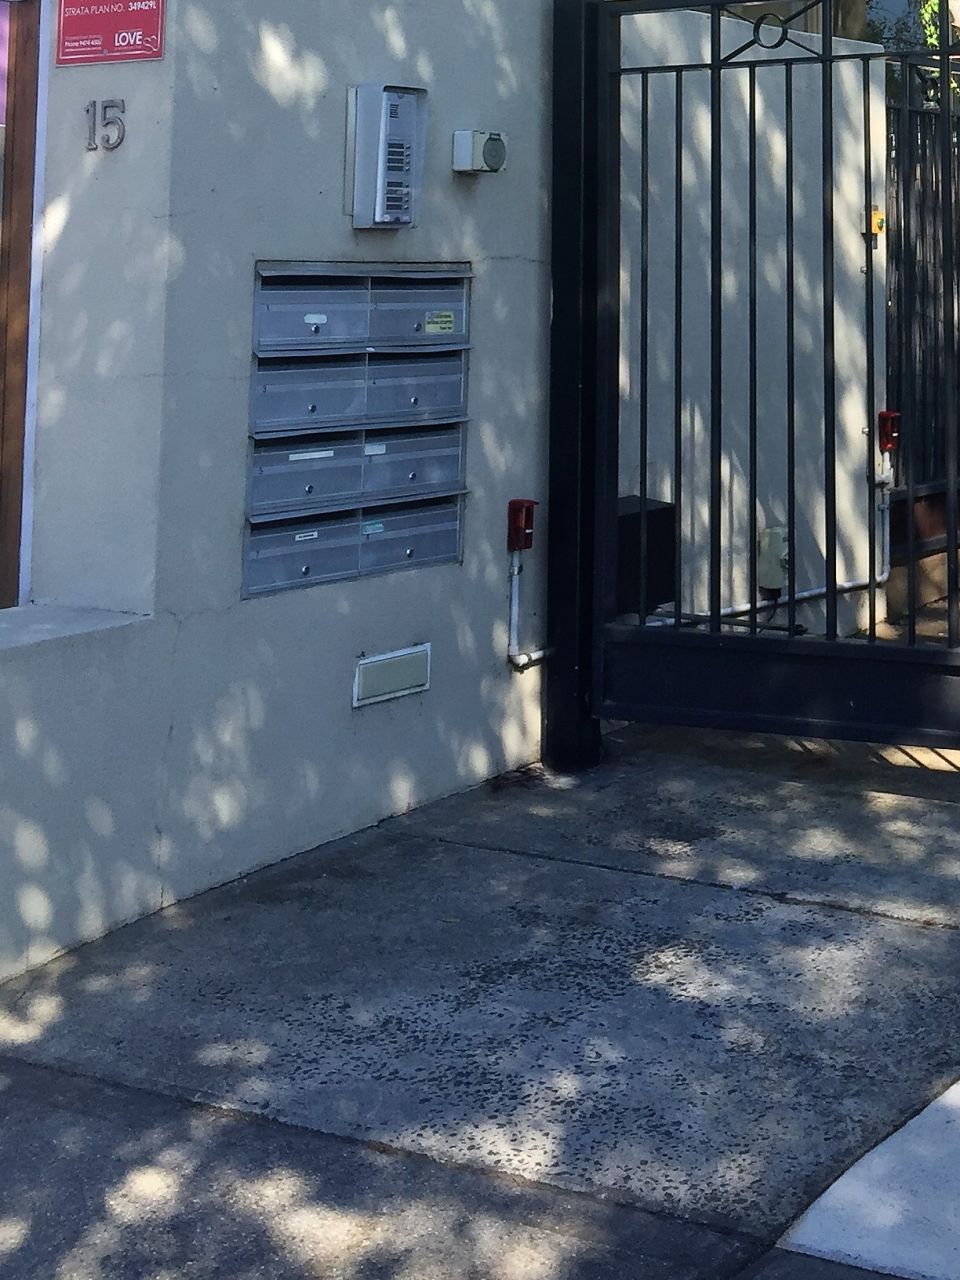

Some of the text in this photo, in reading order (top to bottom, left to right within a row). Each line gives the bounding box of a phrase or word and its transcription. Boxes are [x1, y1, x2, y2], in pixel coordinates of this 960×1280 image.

[65, 7, 89, 17] STRATA
[91, 4, 110, 15] PLAN
[115, 32, 142, 46] LOVE
[84, 96, 126, 152] 15
